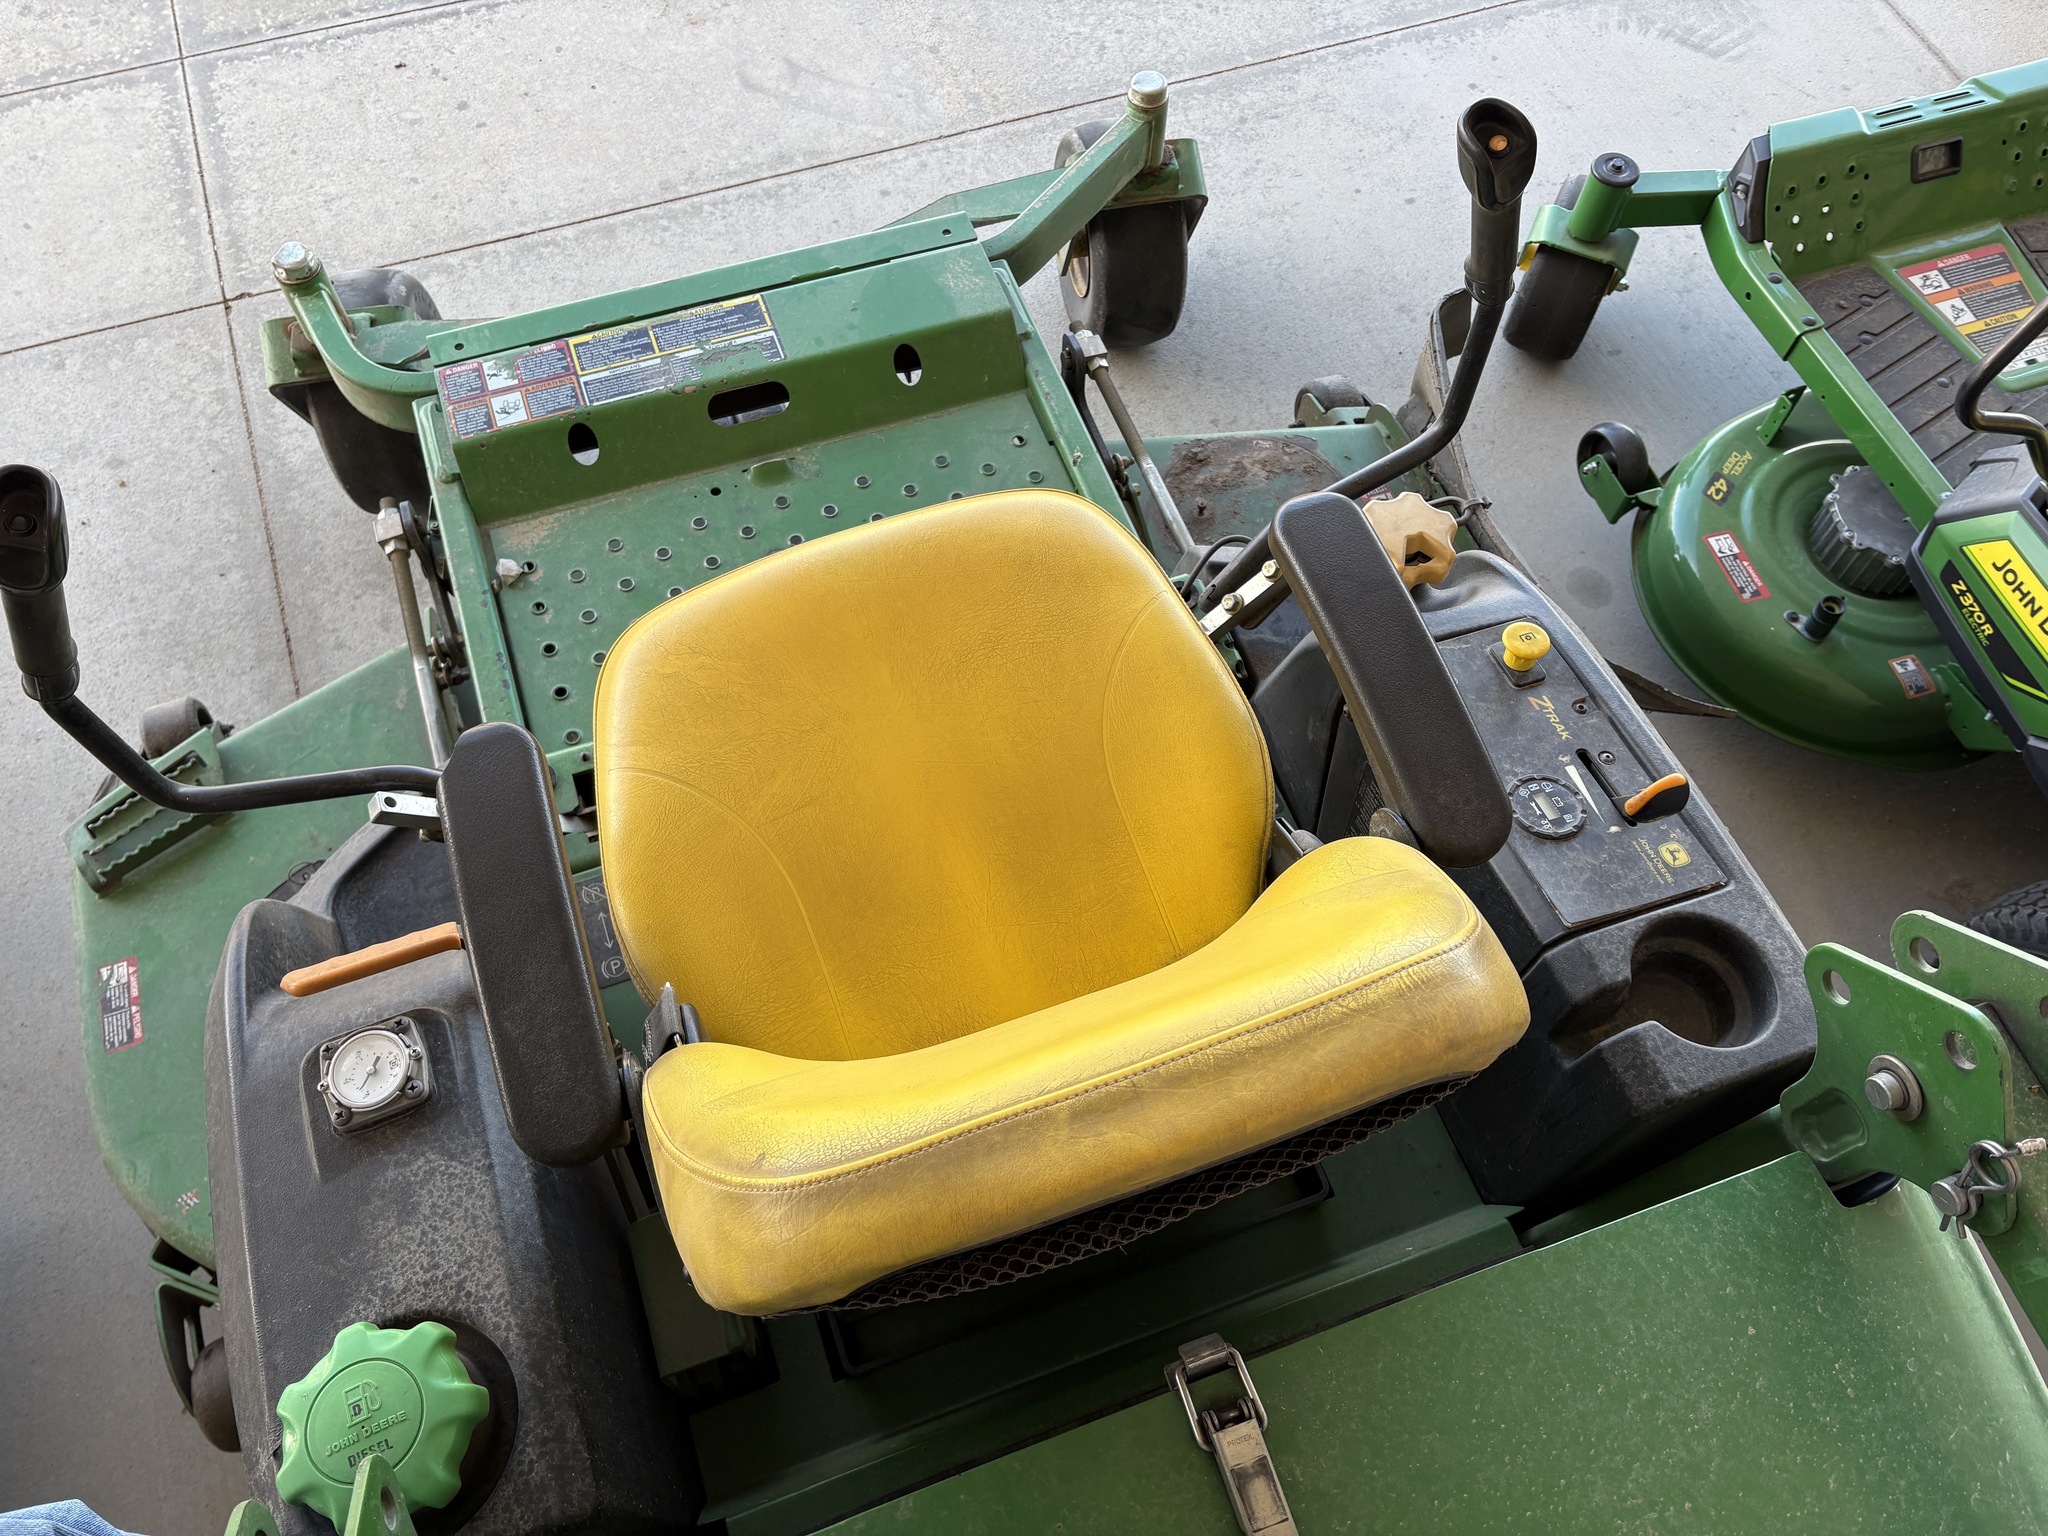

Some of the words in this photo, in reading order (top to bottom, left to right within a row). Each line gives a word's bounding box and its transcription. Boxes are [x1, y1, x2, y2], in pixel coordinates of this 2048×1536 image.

[1943, 254, 1972, 266] DANGER
[1964, 281, 1995, 293] WARNING
[1990, 313, 2019, 325] CAUTION
[452, 362, 479, 373] DANGER
[457, 398, 488, 410] WARNING
[1722, 451, 1741, 475] DEEP
[1730, 450, 1753, 476] ACCEL
[1706, 478, 1728, 500] 42
[1991, 559, 2044, 618] JOHN
[1951, 580, 1994, 637] Z370R
[1962, 608, 1990, 647] ELECTRIC
[1527, 695, 1573, 740] ZTRAK
[1638, 838, 1657, 858] JOHN
[1653, 858, 1675, 884] DEERE
[325, 1433, 359, 1457] JOHN
[361, 1410, 407, 1439] DEERE
[1227, 1433, 1253, 1447] PROTEX
[347, 1438, 394, 1469] DIESEL
